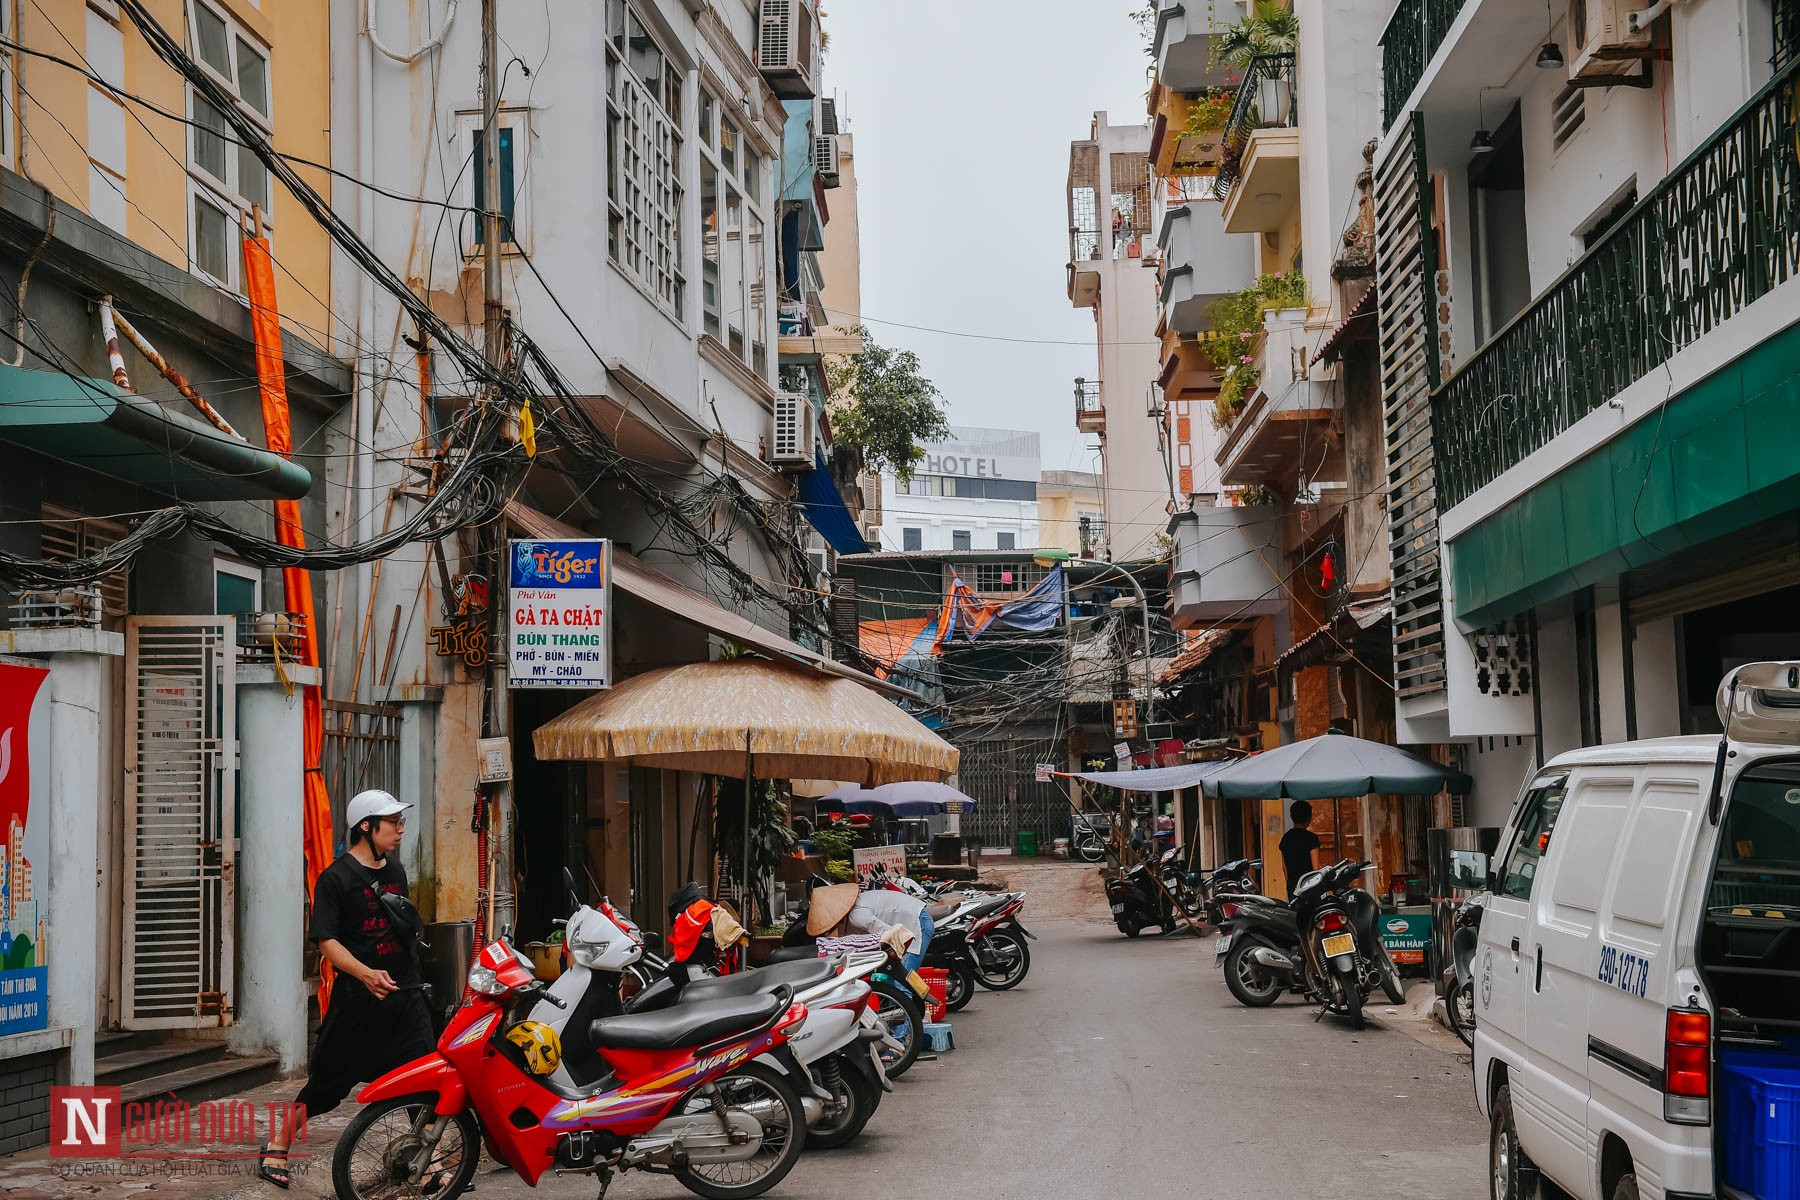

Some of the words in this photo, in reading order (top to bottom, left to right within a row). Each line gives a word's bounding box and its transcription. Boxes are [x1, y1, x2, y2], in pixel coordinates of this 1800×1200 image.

[926, 455, 1002, 477] HOTEL
[533, 551, 597, 583] Tiger
[538, 590, 556, 599] Vân
[516, 604, 536, 625] GÀ
[540, 609, 559, 626] TA
[563, 604, 602, 631] CHẶT
[430, 621, 488, 667] Tig
[517, 631, 547, 646] BÚN
[552, 634, 599, 646] THANG
[516, 648, 536, 661] PHỞ
[545, 650, 565, 661] BÚN
[574, 649, 599, 661] MIẾN
[532, 664, 547, 676] MỲ
[556, 664, 582, 676] CHÁO
[1389, 939, 1405, 948] BÁN
[1407, 938, 1429, 948] HÀN
[1598, 945, 1649, 998] 29D-127.78
[15, 978, 24, 993] THI
[25, 976, 37, 992] ĐUA
[8, 1002, 23, 1020] NĂM
[23, 1002, 38, 1018] 2019
